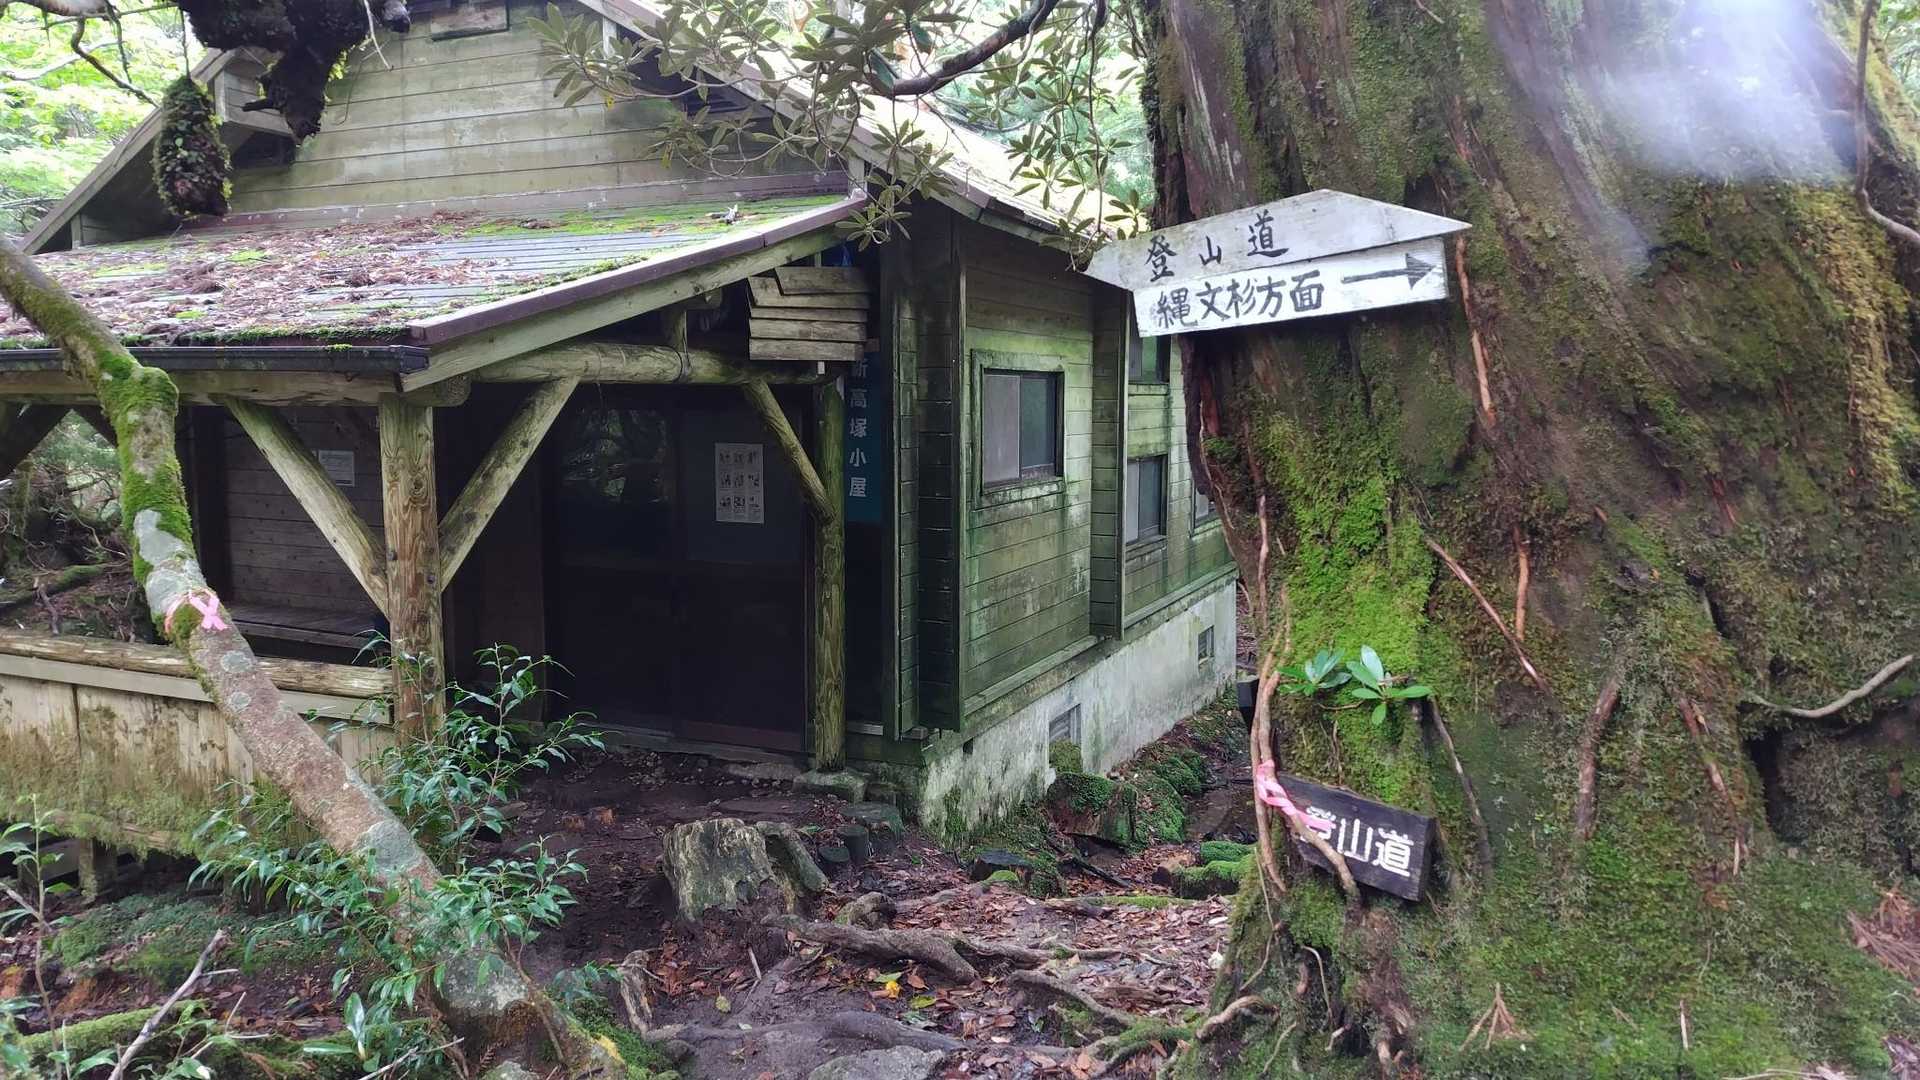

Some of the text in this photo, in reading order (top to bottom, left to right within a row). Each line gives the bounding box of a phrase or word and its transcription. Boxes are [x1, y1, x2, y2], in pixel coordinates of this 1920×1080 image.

[1145, 209, 1289, 283] 登山道
[1155, 270, 1325, 330] 縄文杉方面
